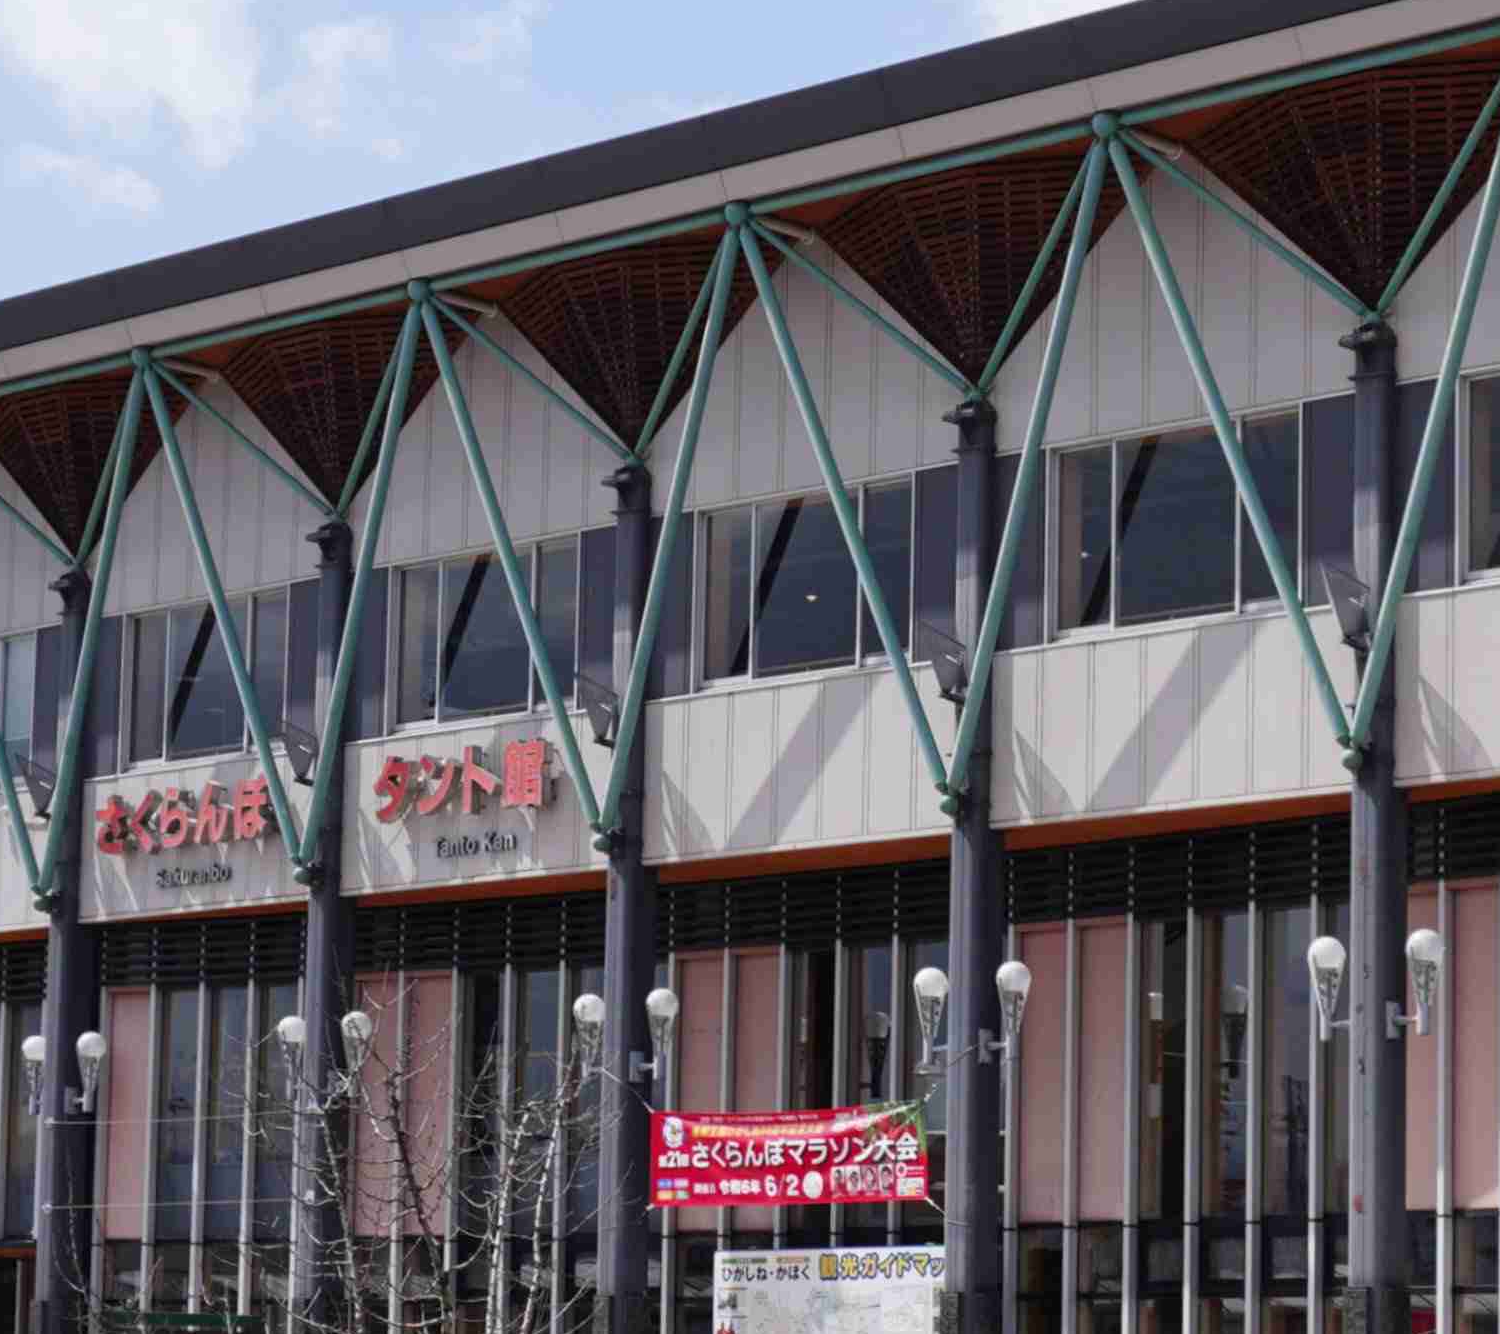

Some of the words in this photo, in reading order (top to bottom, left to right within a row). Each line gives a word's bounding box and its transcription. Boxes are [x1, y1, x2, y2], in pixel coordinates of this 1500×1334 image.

[373, 738, 549, 824] タント館
[437, 835, 480, 859] Tanto
[482, 829, 517, 853] Kan
[691, 1131, 919, 1169] さくらんぼマラソン大会
